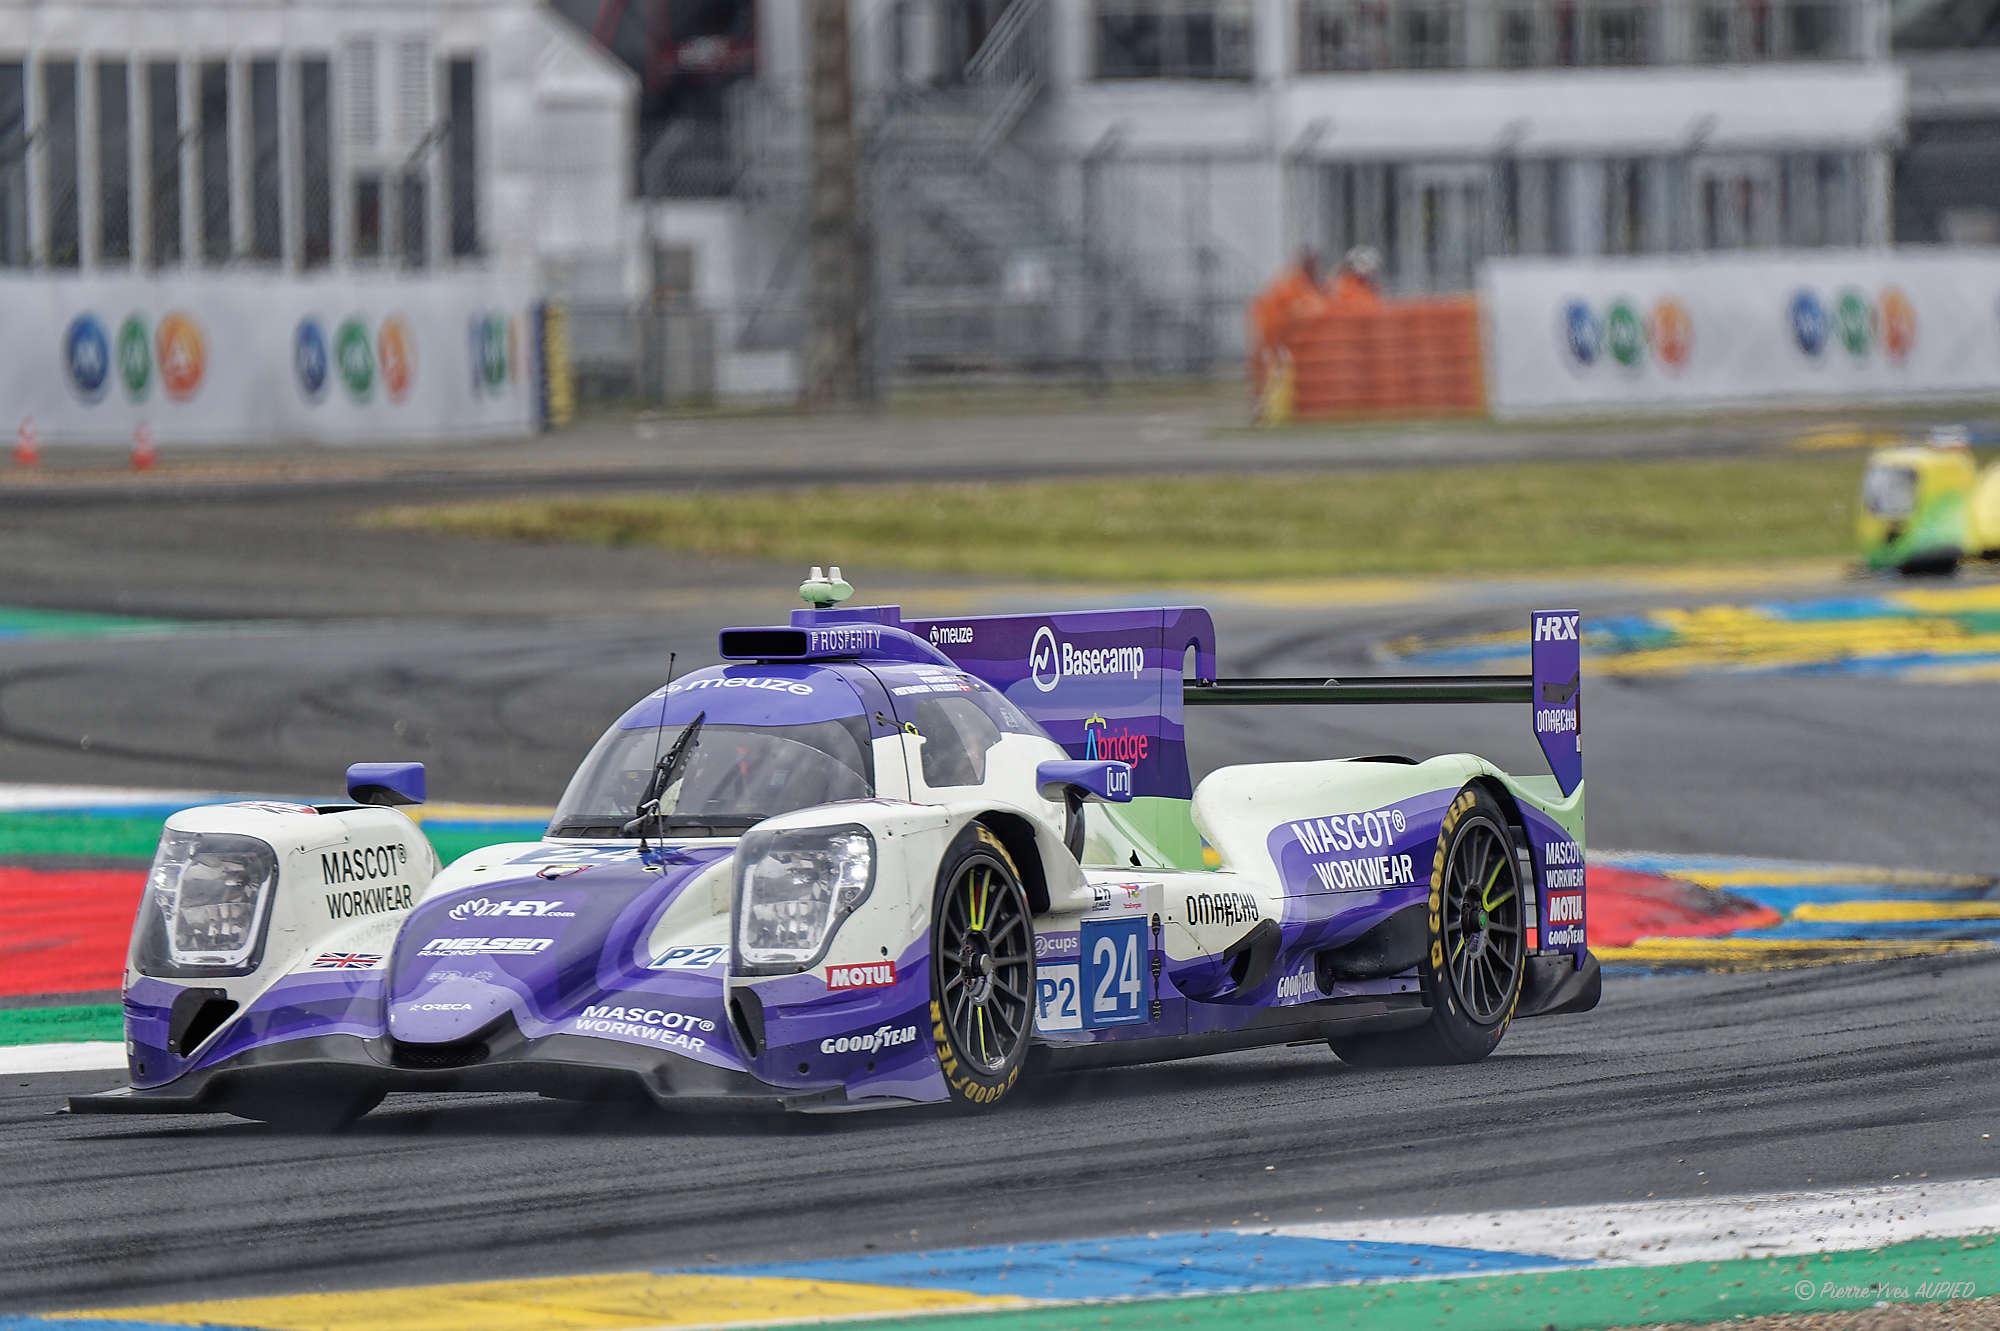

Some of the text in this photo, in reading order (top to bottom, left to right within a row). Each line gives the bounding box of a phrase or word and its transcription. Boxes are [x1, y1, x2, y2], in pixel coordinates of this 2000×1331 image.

[811, 630, 881, 651] PROSPERITY
[940, 626, 973, 644] meuze
[1535, 616, 1578, 641] HRX
[1062, 643, 1144, 679] Basecamp
[685, 677, 814, 696] meuze
[1537, 709, 1576, 734] OMARCHY
[1313, 855, 1414, 890] WORKWEAR
[1546, 868, 1584, 889] WORKWEAR
[325, 884, 413, 919] WORKWEAR
[1186, 893, 1259, 927] OMARCHY
[1549, 895, 1583, 922] MOTUL
[421, 938, 555, 951] NIELSEN
[1548, 924, 1584, 949] GOODYEAR
[655, 946, 724, 967] P2
[830, 966, 894, 988] MOTUL
[1093, 934, 1141, 1012] 24
[421, 1003, 472, 1011] ORECA
[1037, 978, 1077, 1018] P2
[575, 1019, 706, 1053] WORKWEAR
[820, 1026, 917, 1055] GOODYEAR
